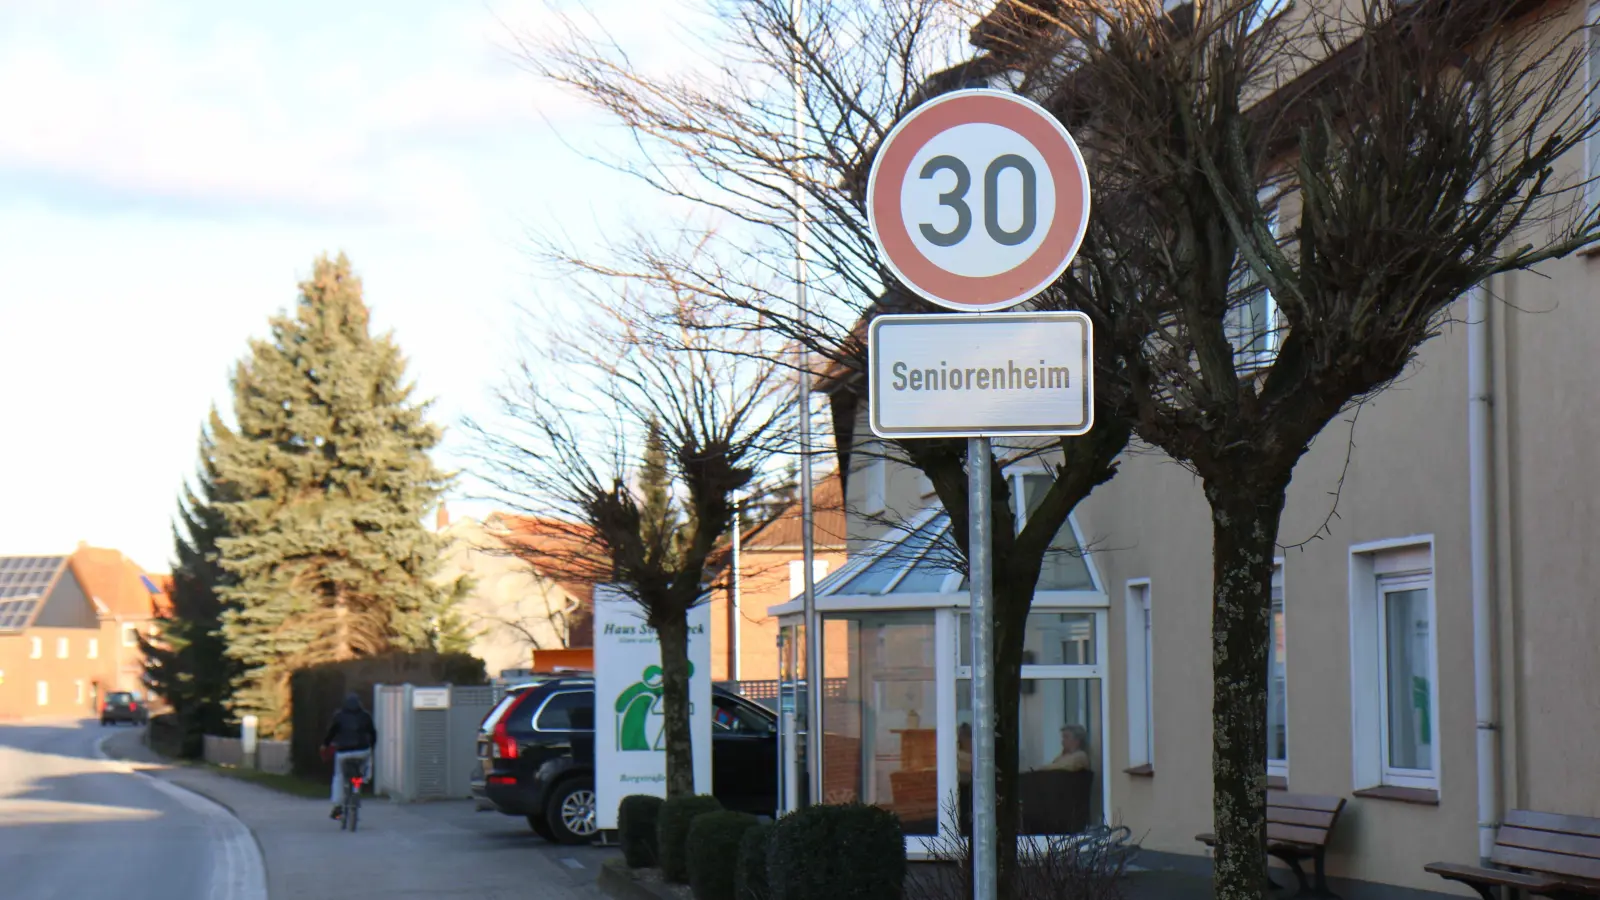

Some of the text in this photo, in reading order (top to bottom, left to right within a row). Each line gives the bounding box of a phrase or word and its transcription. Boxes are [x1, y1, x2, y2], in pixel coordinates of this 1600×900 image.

[918, 153, 1037, 247] 30
[892, 359, 1070, 391] Seniorenheim
[603, 623, 635, 635] Haus
